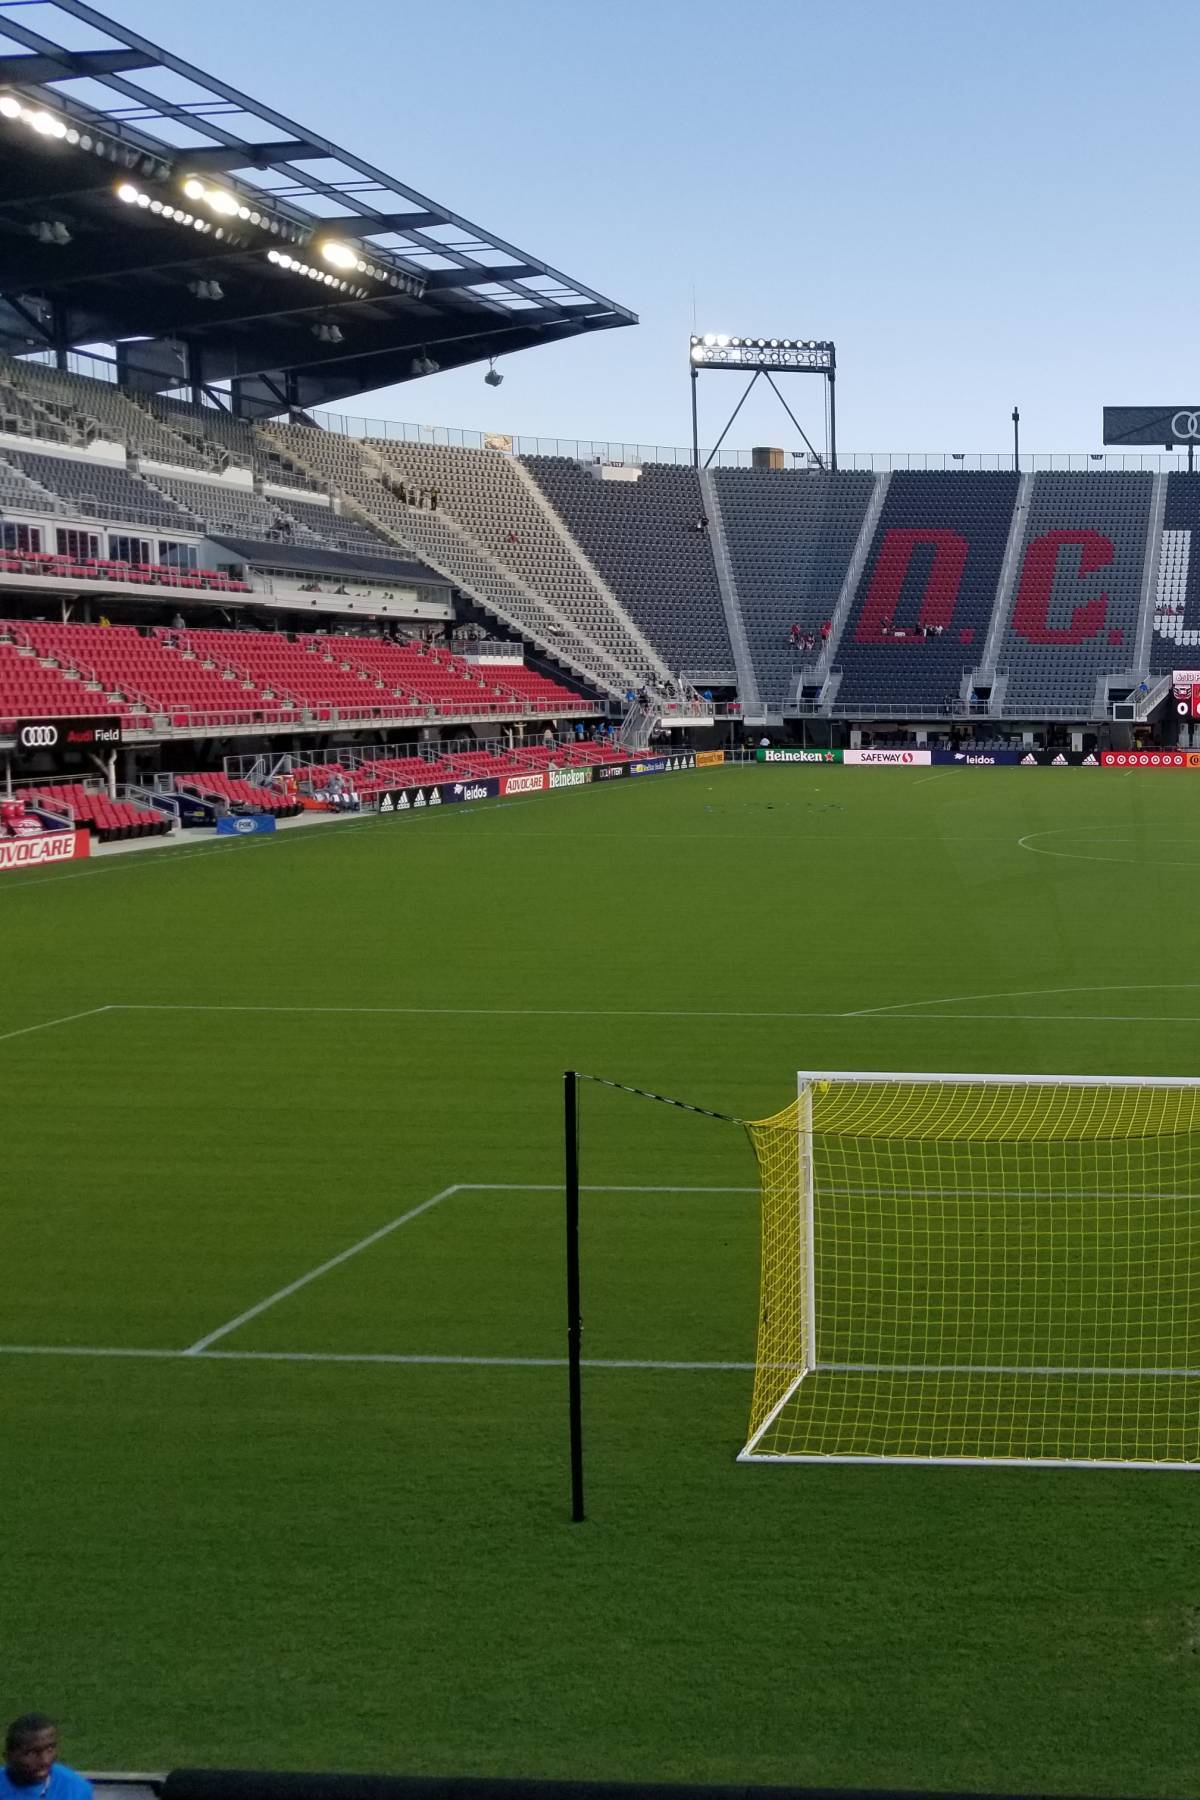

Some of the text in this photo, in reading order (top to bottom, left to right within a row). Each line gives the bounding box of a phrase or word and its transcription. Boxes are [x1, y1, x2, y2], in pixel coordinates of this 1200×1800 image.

[1177, 702, 1188, 715] 0
[67, 729, 120, 742] Audi Field
[765, 750, 823, 762] Heineken
[861, 753, 901, 762] SAFEWAY
[966, 754, 995, 764] leidos
[507, 776, 544, 792] ADVOCARE
[549, 769, 585, 788] Heineken
[464, 784, 488, 801] leidos
